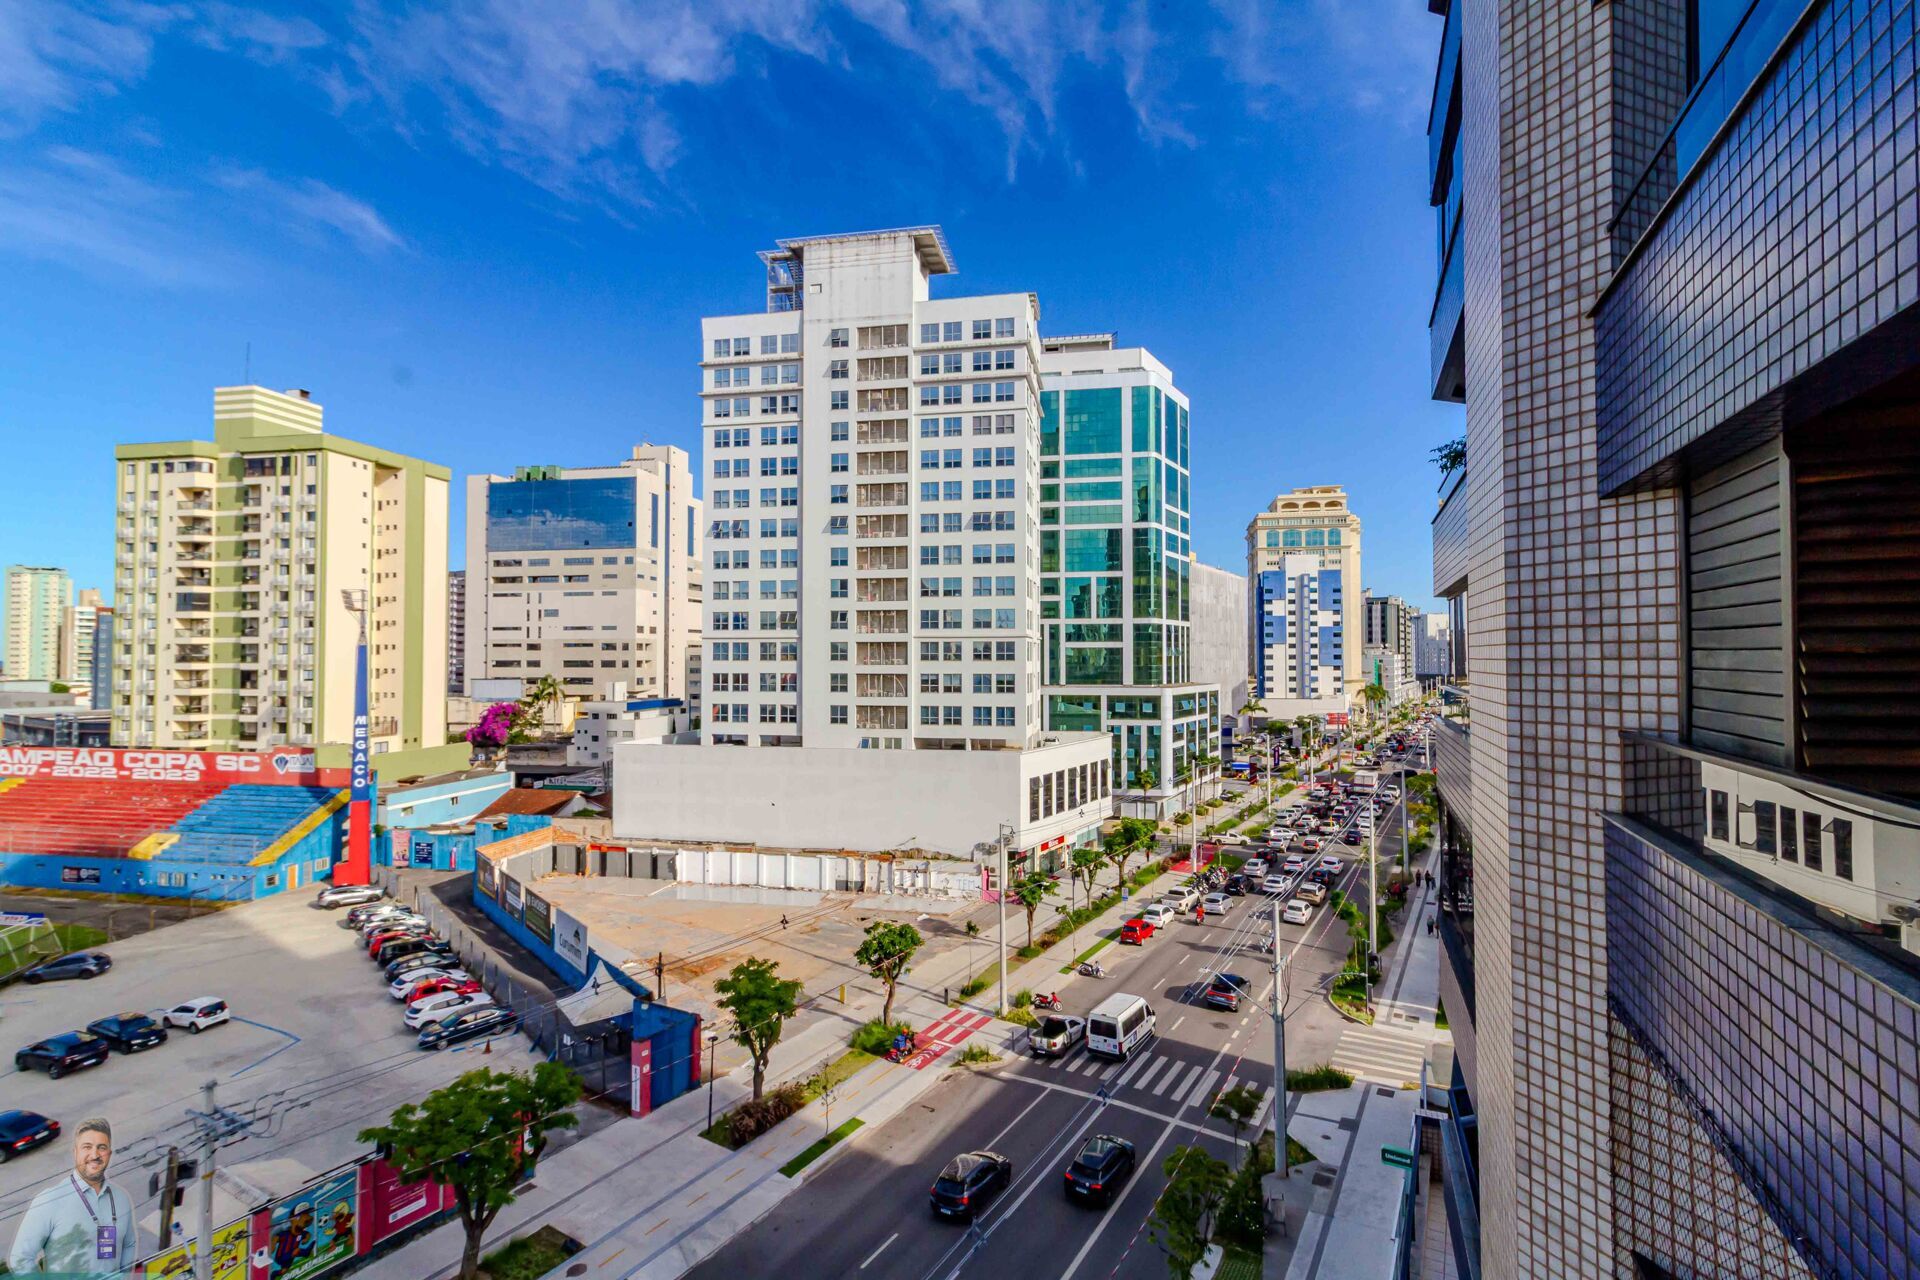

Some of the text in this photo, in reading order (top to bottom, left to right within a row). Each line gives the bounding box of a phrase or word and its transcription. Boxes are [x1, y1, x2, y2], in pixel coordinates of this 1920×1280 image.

[123, 751, 207, 770] COPA
[215, 754, 260, 772] SC
[354, 715, 367, 788] MEGAÇO
